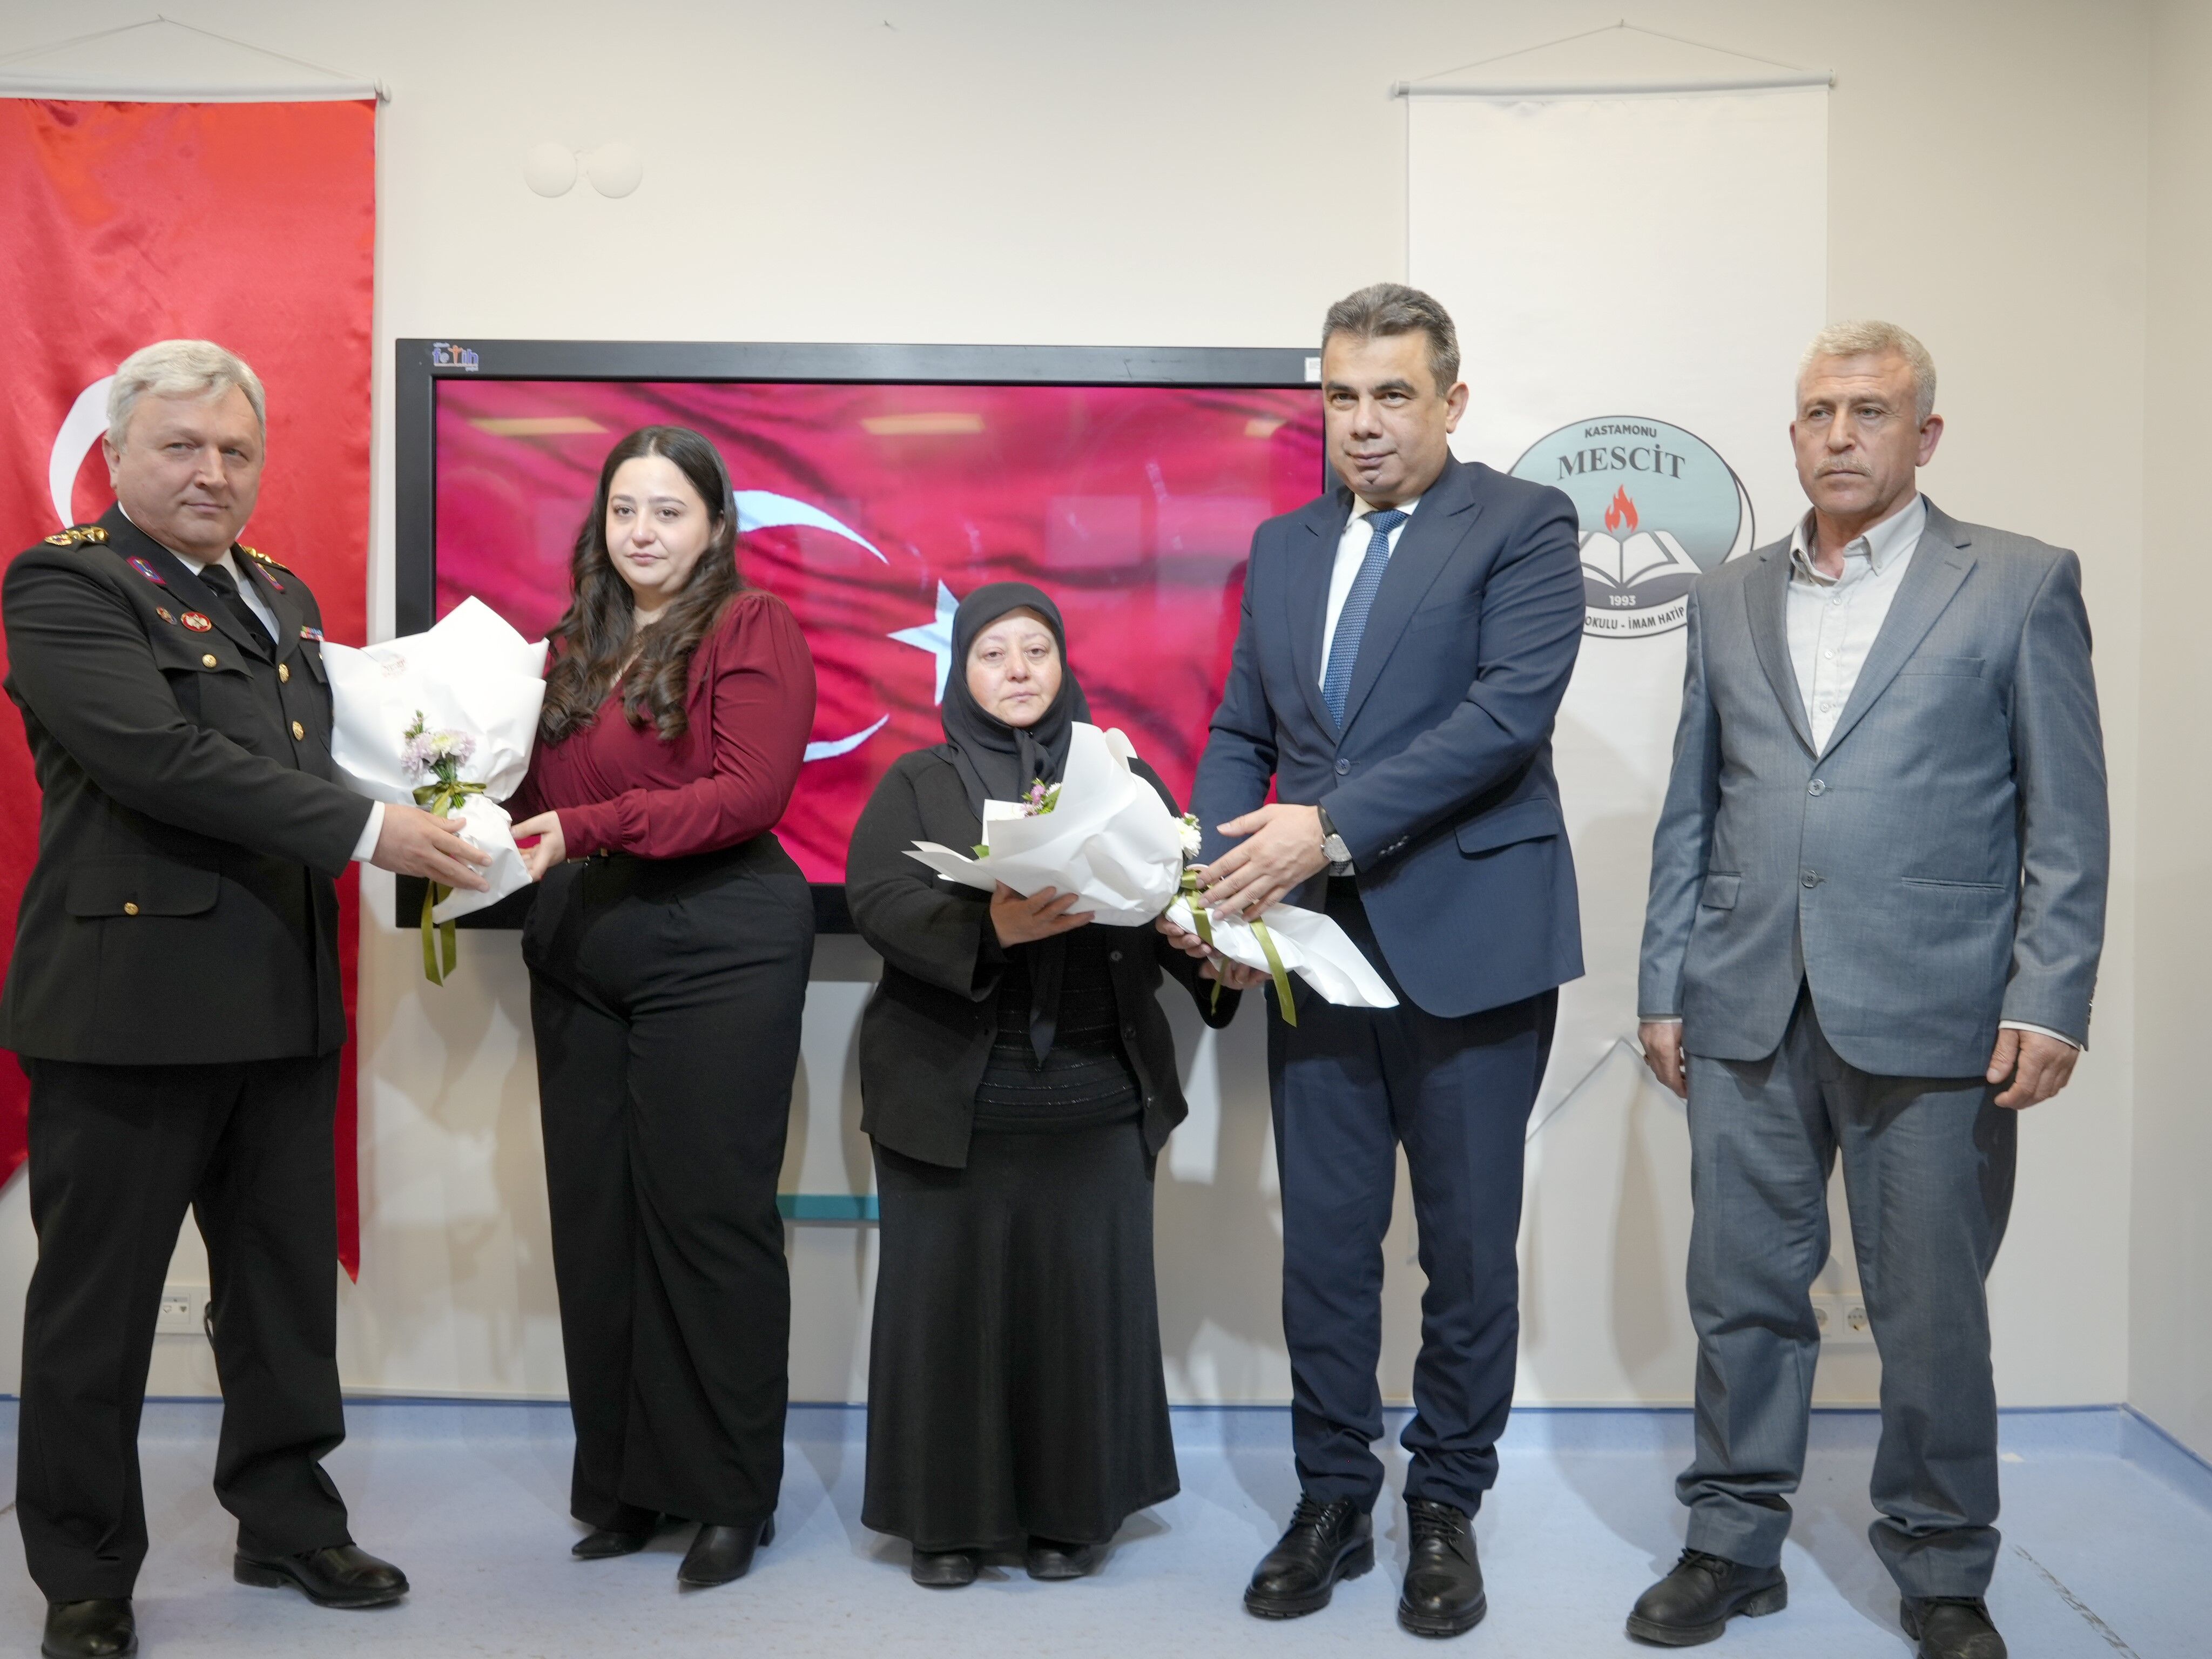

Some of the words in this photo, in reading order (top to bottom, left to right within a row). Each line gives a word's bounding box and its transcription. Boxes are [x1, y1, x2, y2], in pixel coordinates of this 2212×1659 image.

[1584, 424, 1657, 438] KASTAMONU
[1557, 444, 1686, 481] MESCİT
[1609, 595, 1636, 606] 1993
[1629, 616, 1656, 630] İMAM
[1658, 606, 1685, 625] HATİP
